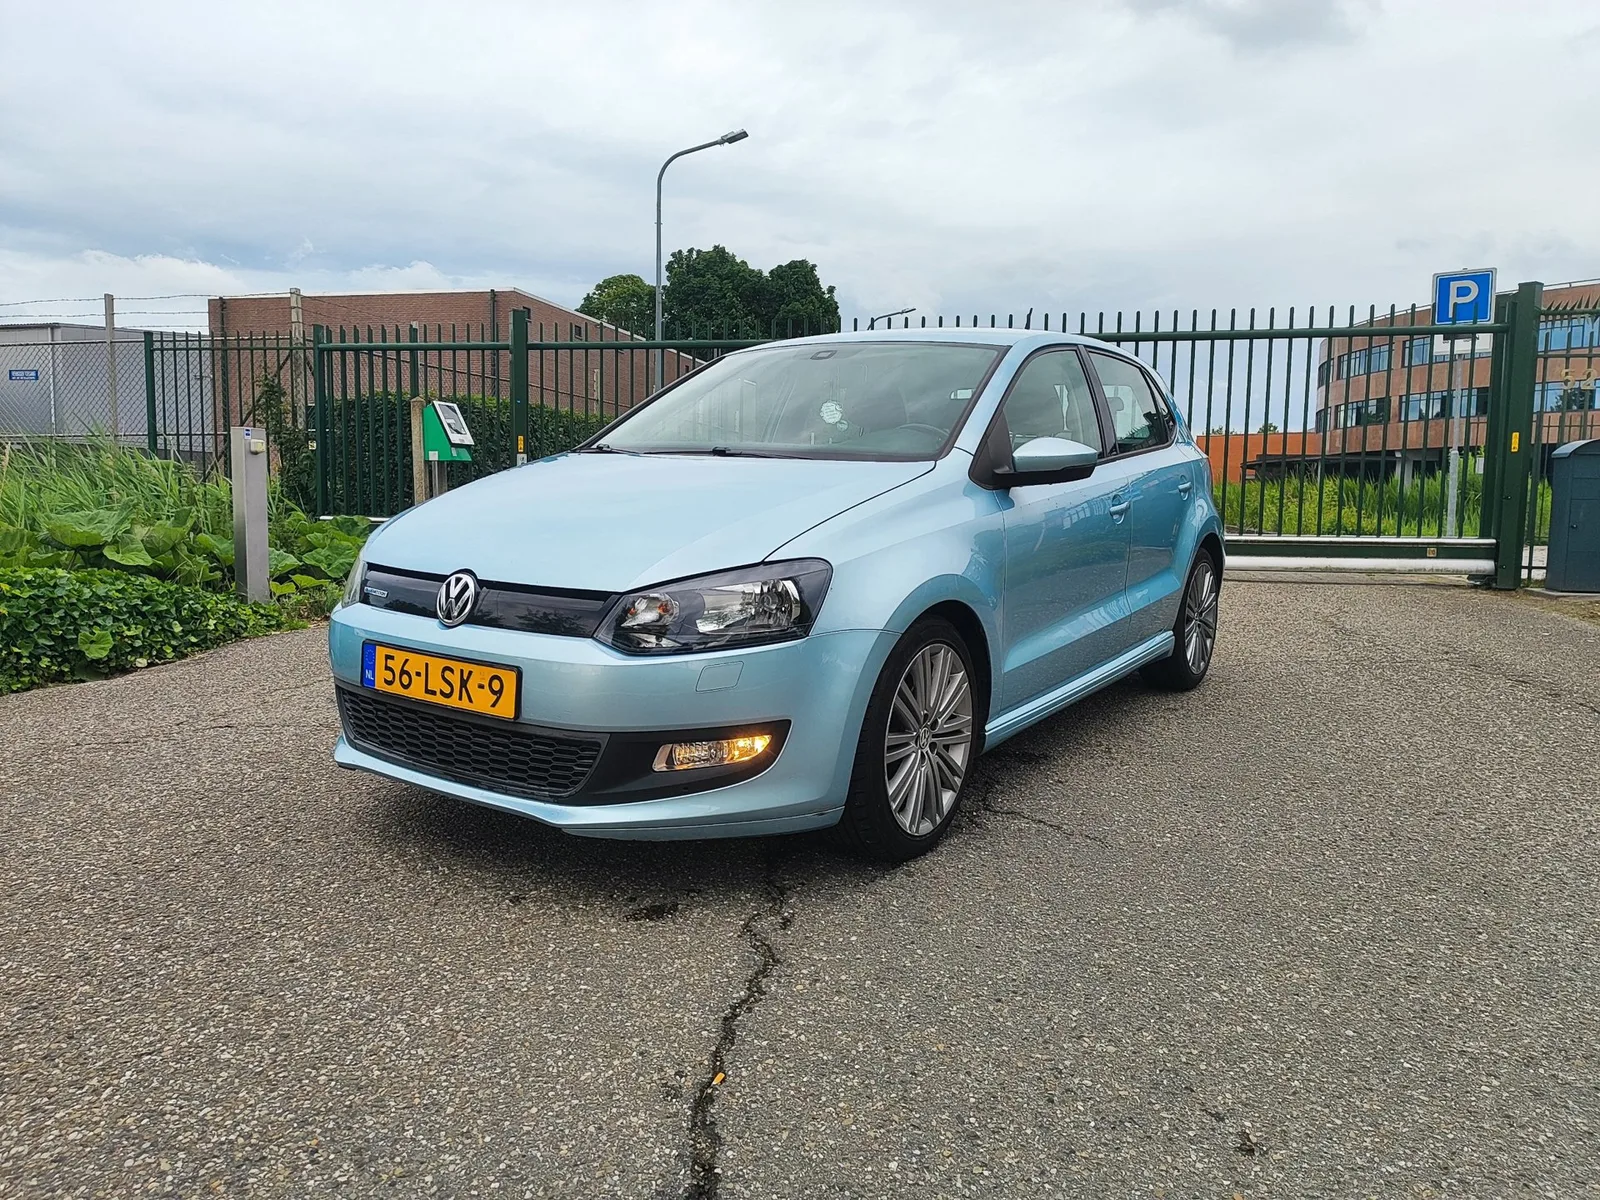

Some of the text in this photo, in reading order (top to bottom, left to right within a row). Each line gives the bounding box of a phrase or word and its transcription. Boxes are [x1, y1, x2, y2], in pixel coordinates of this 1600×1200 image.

[1448, 279, 1479, 319] P
[1560, 368, 1598, 390] 52
[365, 669, 374, 681] NL
[383, 653, 505, 708] 56-LSK-9
